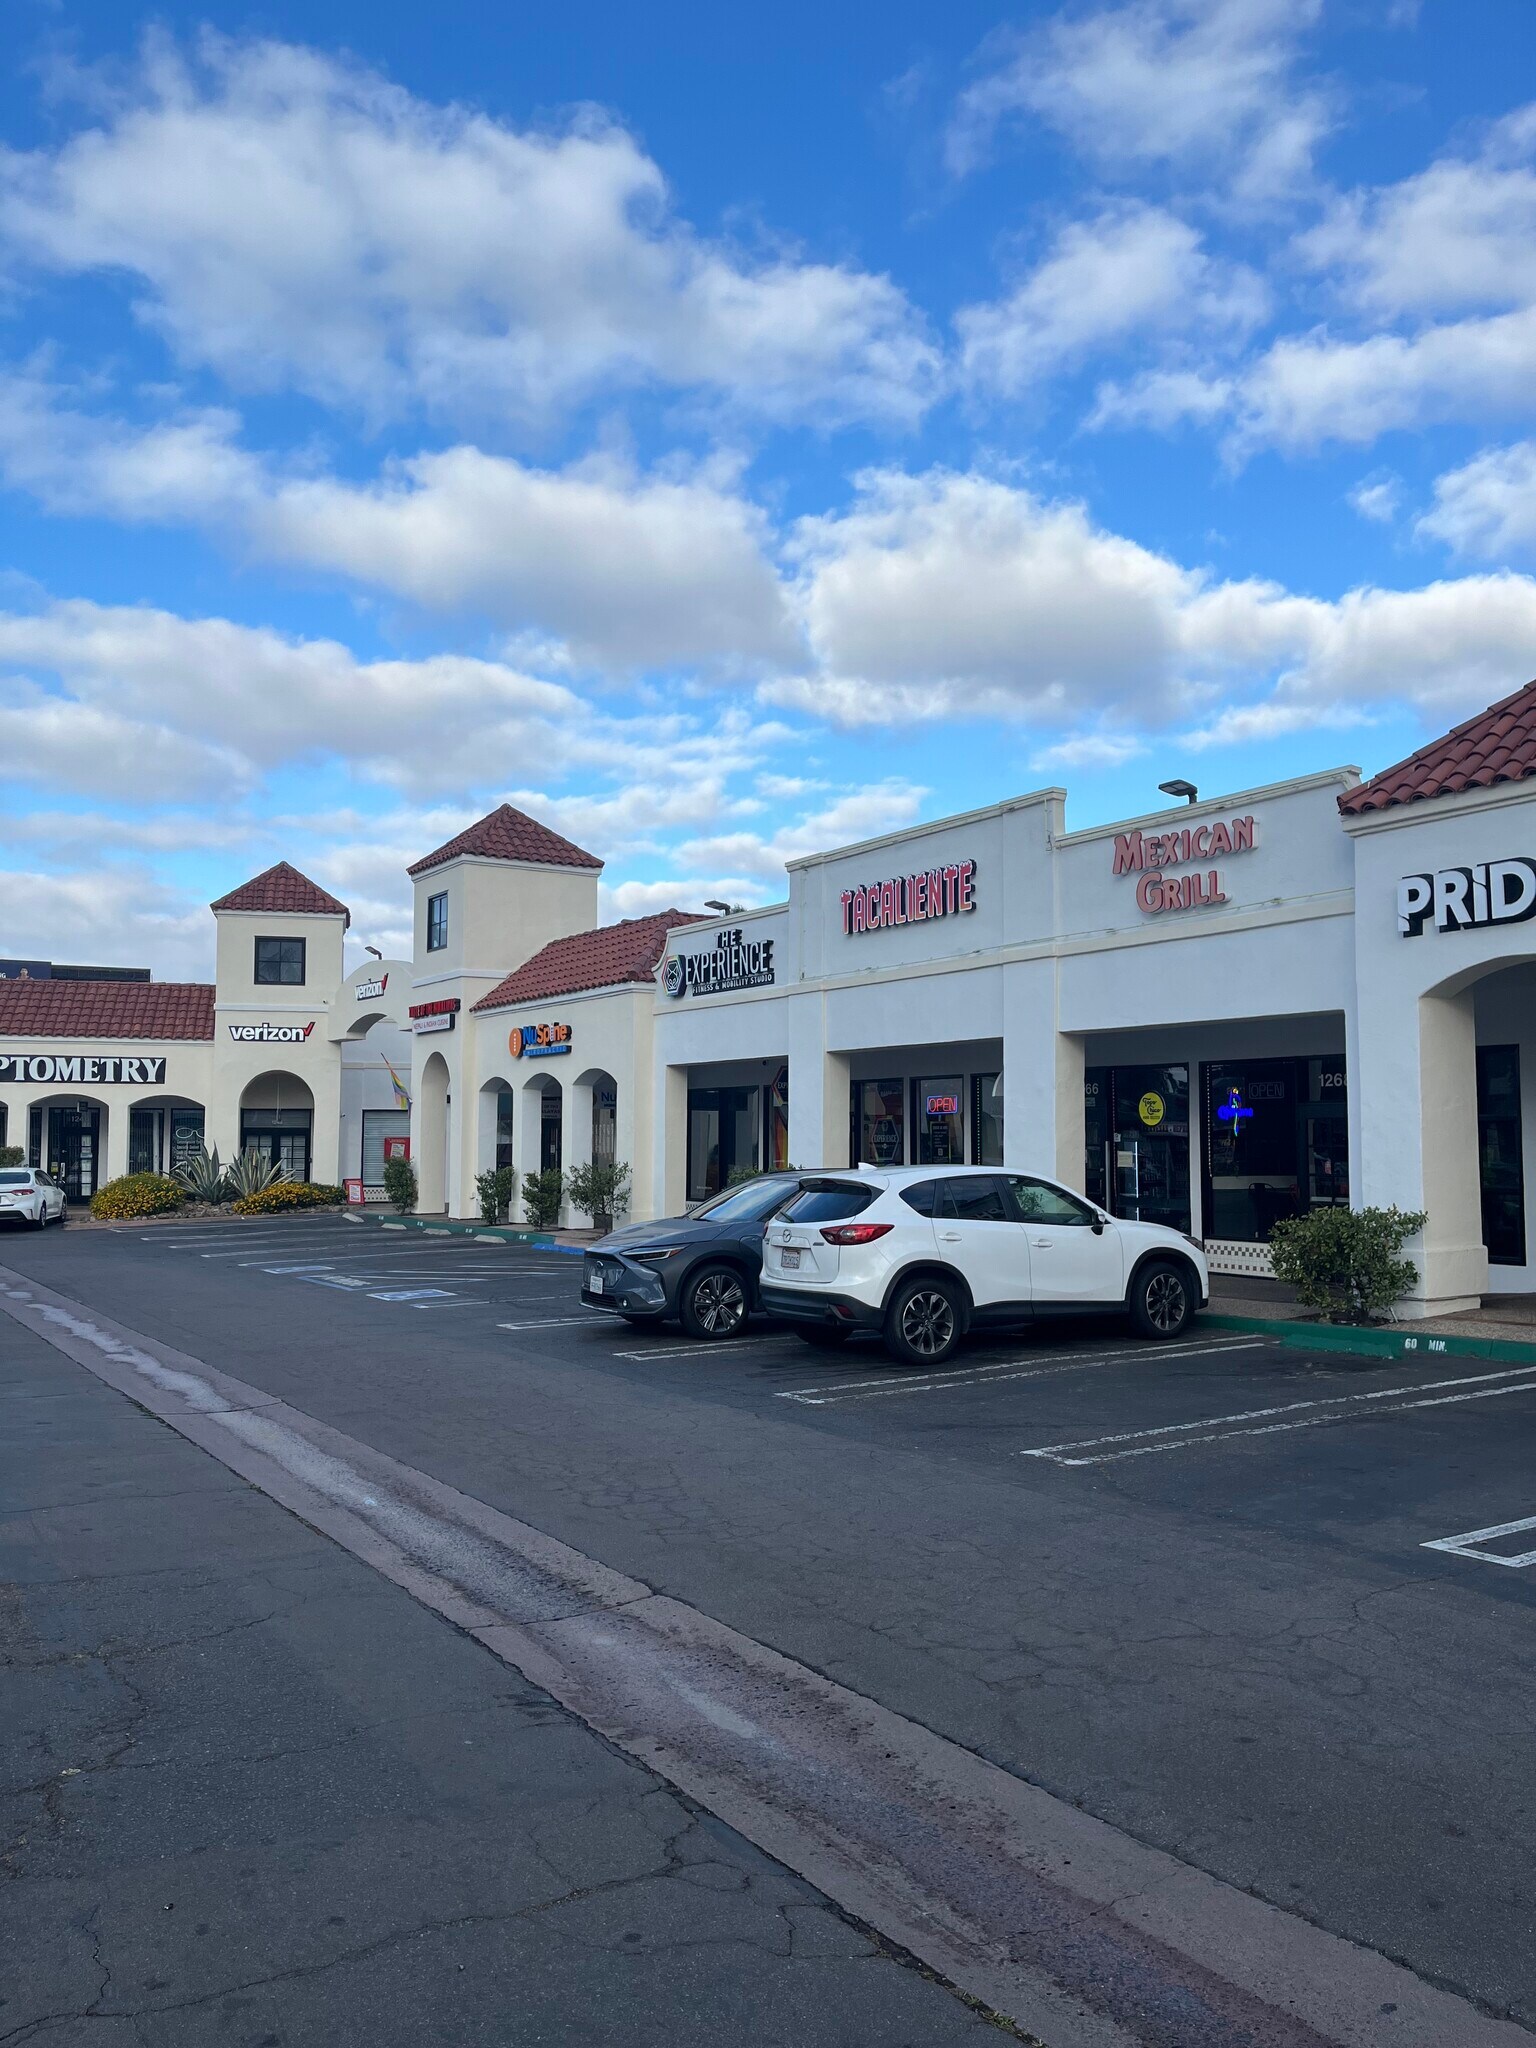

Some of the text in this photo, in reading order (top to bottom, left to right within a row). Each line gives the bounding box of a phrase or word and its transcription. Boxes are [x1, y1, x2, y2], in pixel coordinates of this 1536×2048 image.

[1112, 815, 1255, 875] MEXICAN
[840, 860, 973, 935] TACALIENTE
[1135, 870, 1226, 914] GRILL
[1397, 859, 1536, 934] PRID
[714, 929, 737, 949] THE
[684, 940, 768, 985] EXPERIENCE
[355, 978, 383, 1000] verizon
[692, 984, 714, 995] FITNESS
[722, 977, 749, 989] MOBILITY
[750, 973, 773, 985] STUDIO
[230, 1023, 305, 1042] verizon
[523, 1023, 568, 1046] NuSpine
[1250, 1083, 1283, 1098] OPEN
[928, 1097, 956, 1112] OPEN
[1405, 1338, 1448, 1352] 60 MIN.
